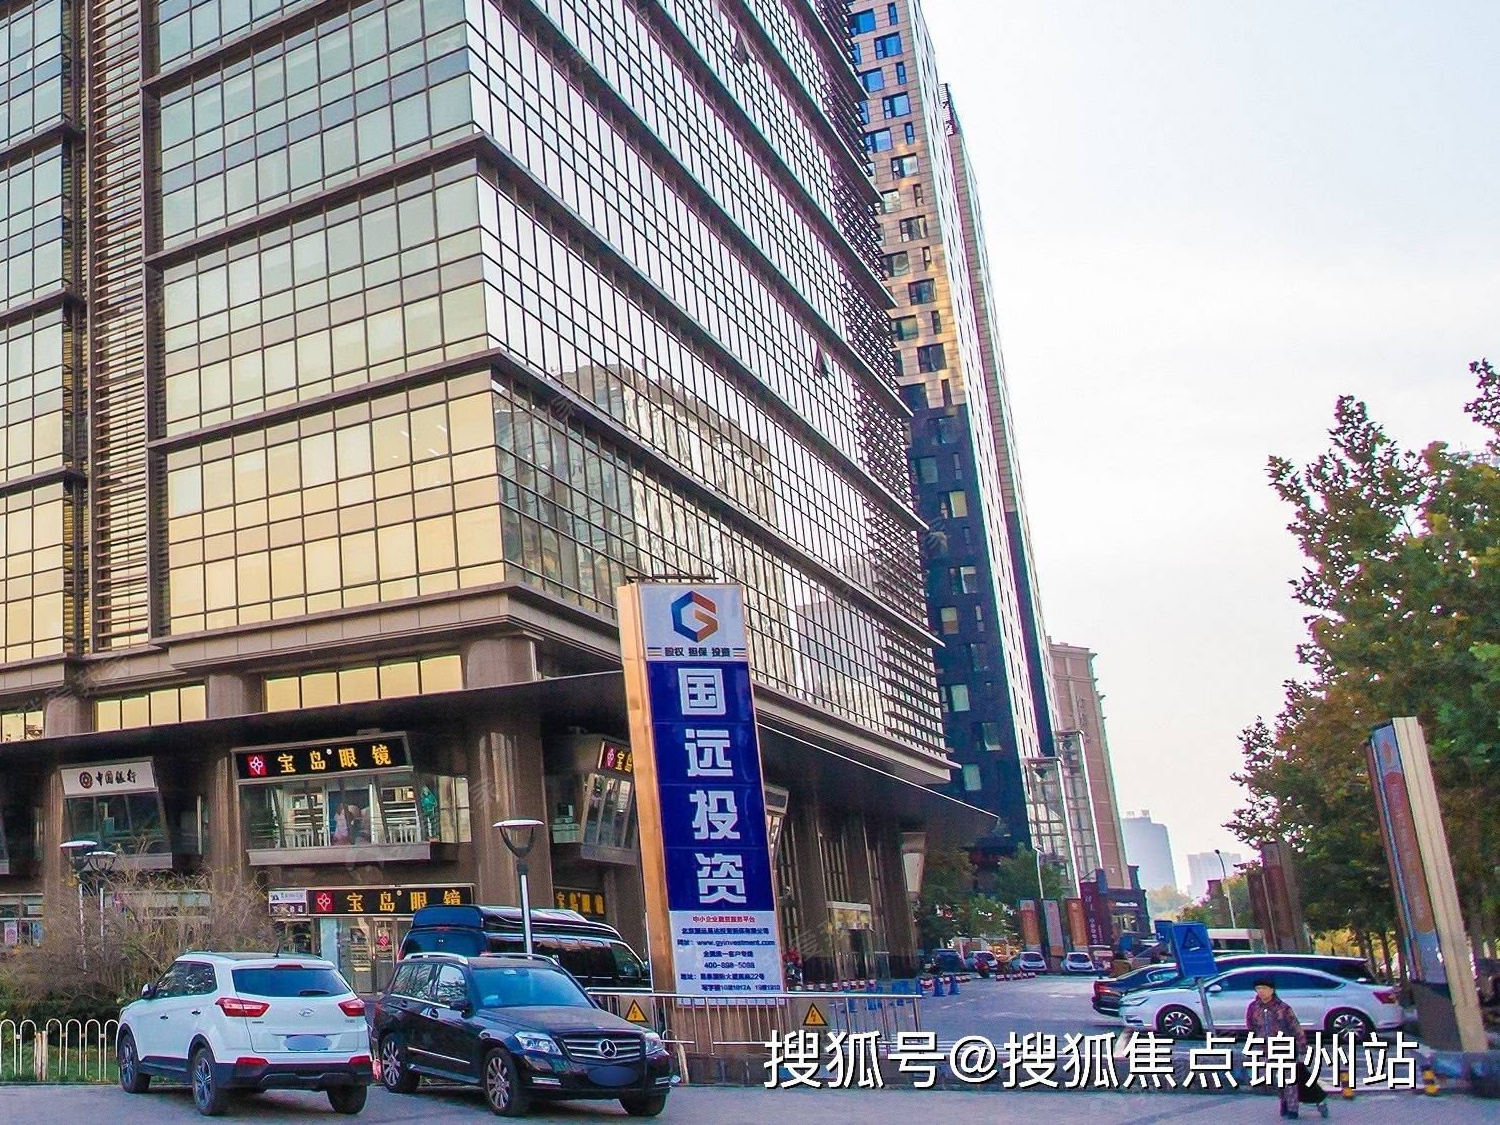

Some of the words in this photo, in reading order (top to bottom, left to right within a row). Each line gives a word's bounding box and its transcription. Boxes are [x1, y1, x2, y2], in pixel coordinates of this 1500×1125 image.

[688, 647, 707, 657] 担保
[712, 648, 731, 657] 投资
[278, 744, 391, 773] 宝岛眼镜
[96, 769, 136, 786] 中国银行
[677, 668, 746, 903] 国远投资
